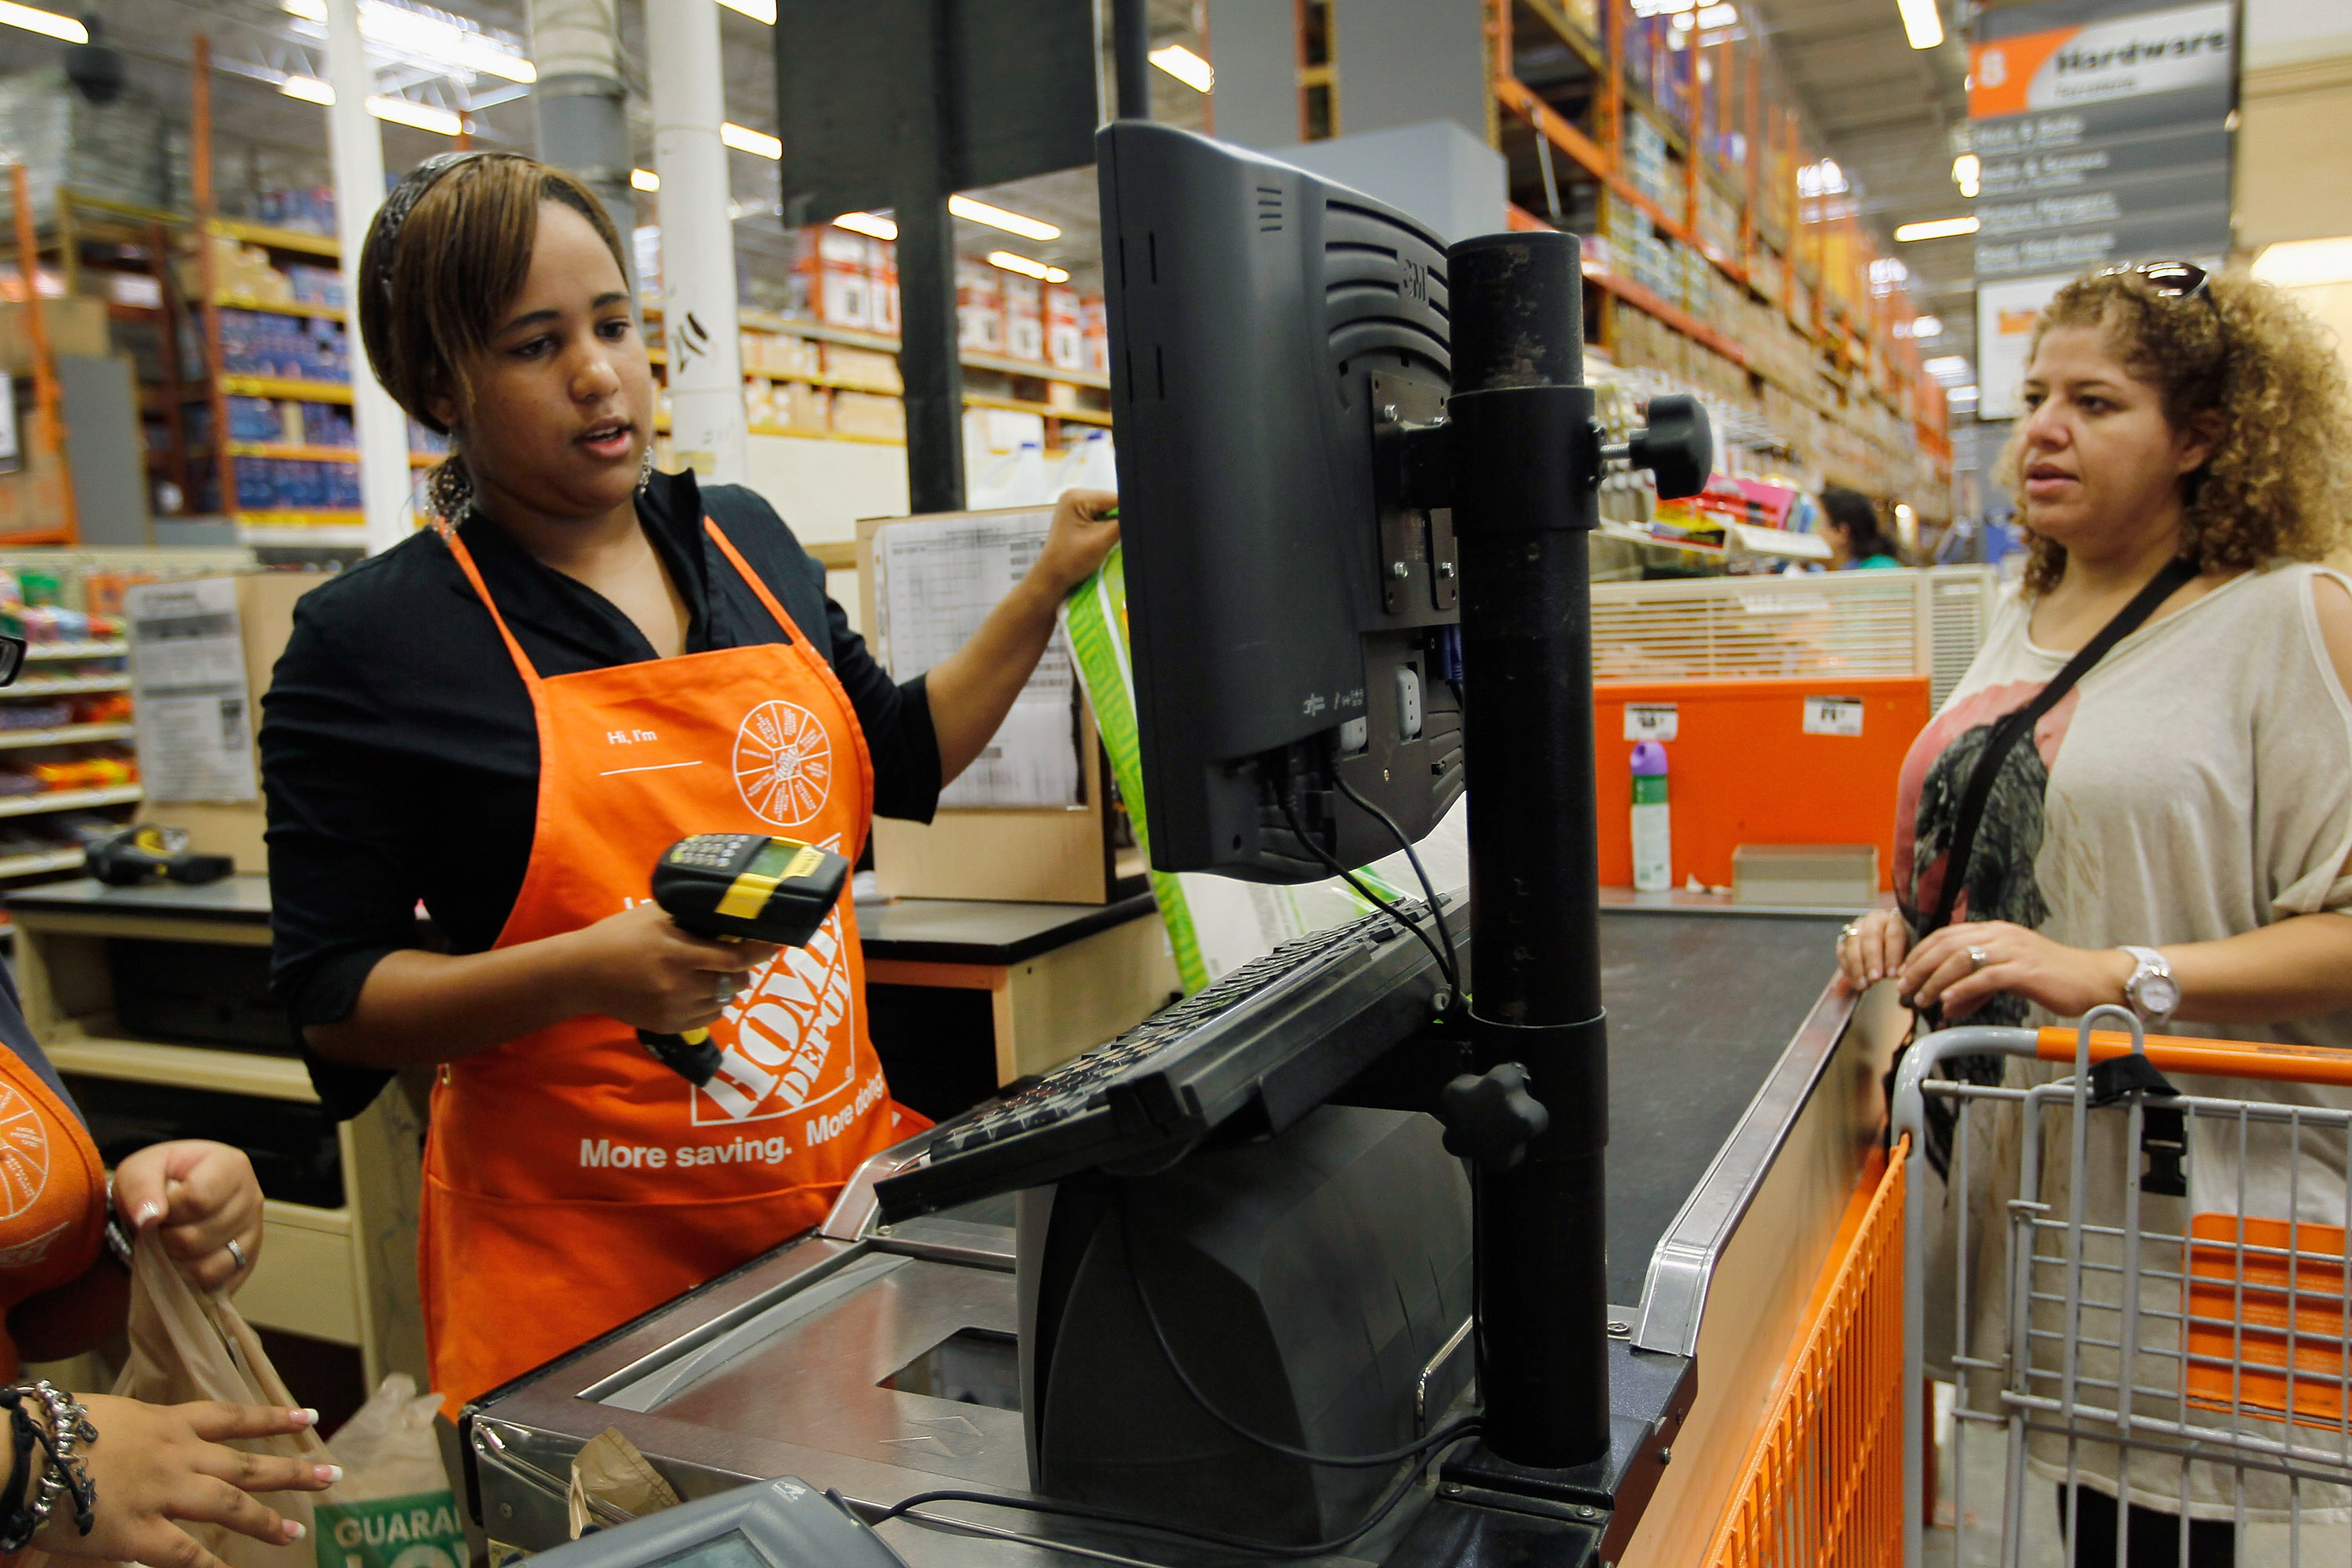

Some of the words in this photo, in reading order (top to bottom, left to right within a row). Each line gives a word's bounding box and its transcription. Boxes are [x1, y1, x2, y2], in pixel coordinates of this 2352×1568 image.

[2056, 29, 2228, 74] Hardware
[607, 731, 632, 745] Hi,
[632, 729, 658, 742] I'm
[775, 962, 850, 1107] DEPOT
[806, 1104, 854, 1147] More
[580, 1138, 667, 1168] More
[675, 1136, 792, 1167] saving.
